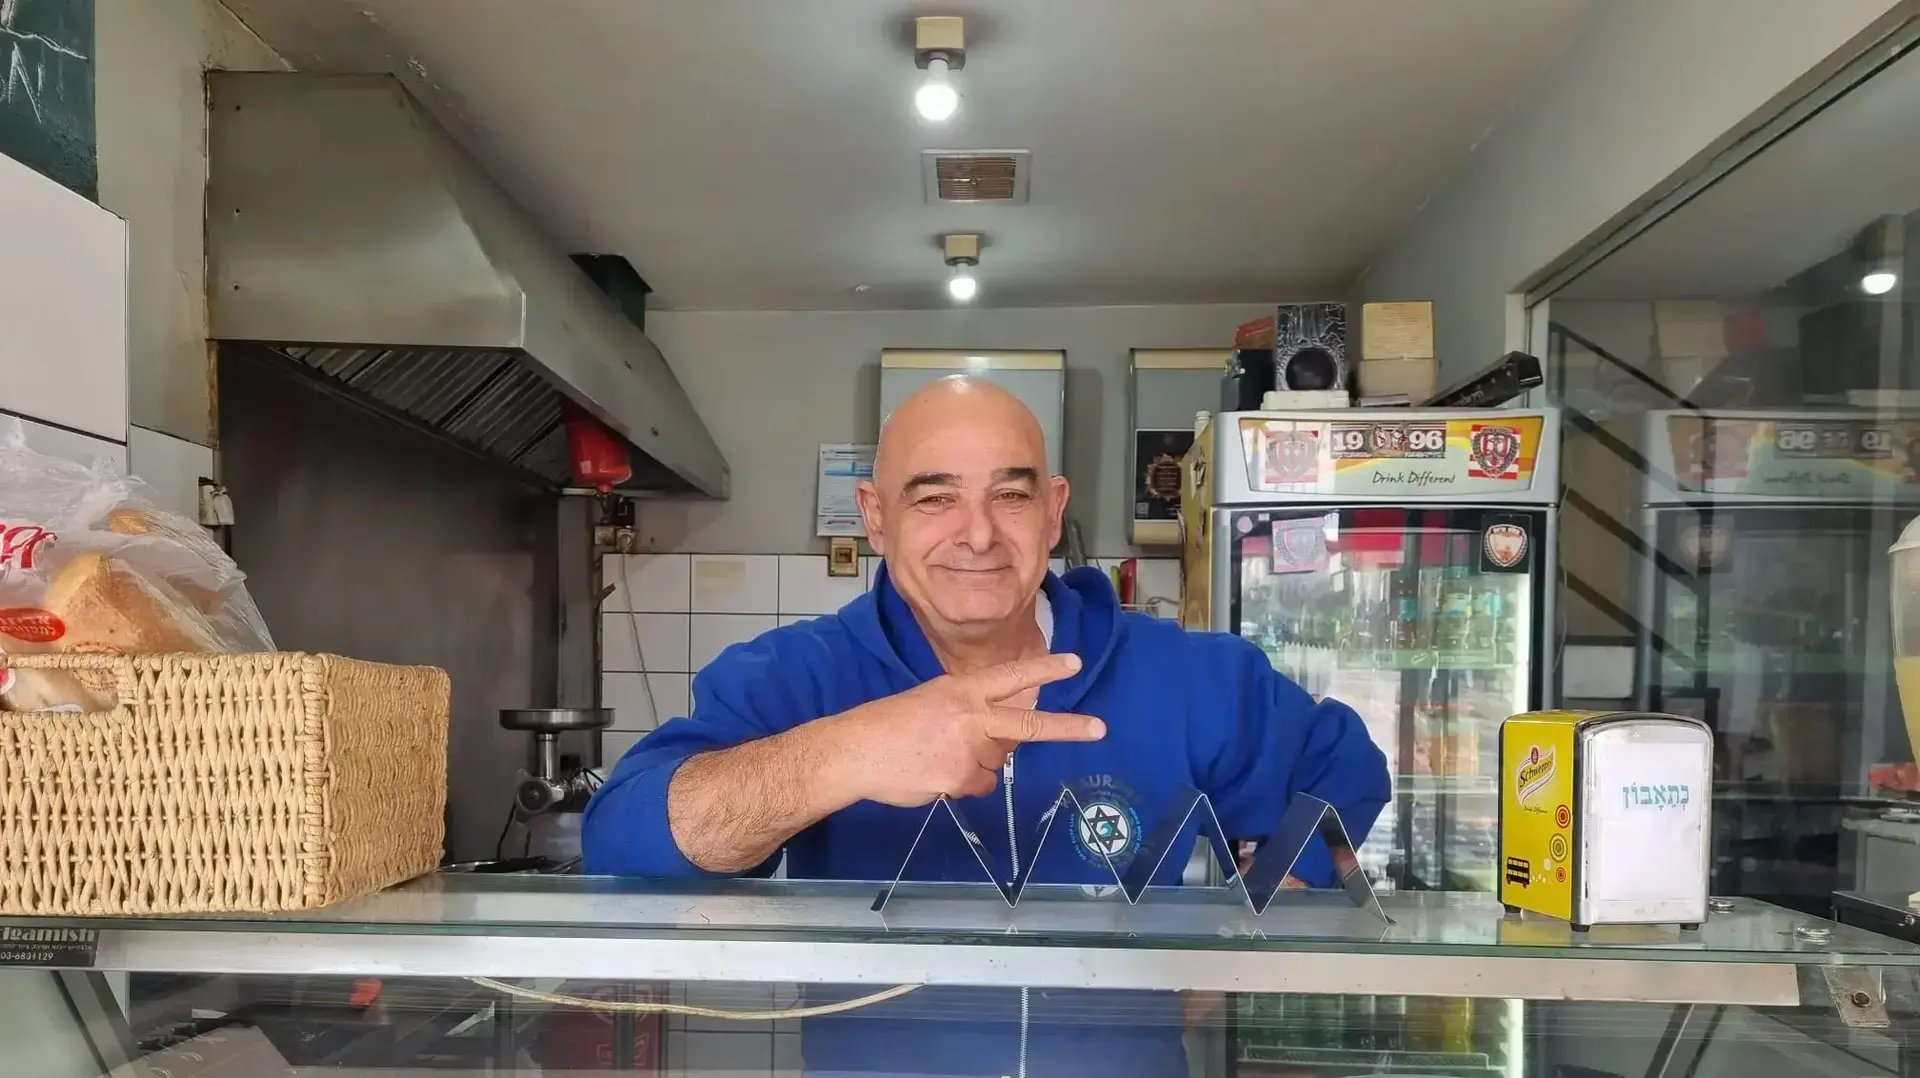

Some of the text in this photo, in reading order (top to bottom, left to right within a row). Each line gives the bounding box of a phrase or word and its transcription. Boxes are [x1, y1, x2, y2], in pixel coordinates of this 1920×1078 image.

[1333, 430, 1443, 451] 19 96
[1372, 471, 1404, 484] Drink
